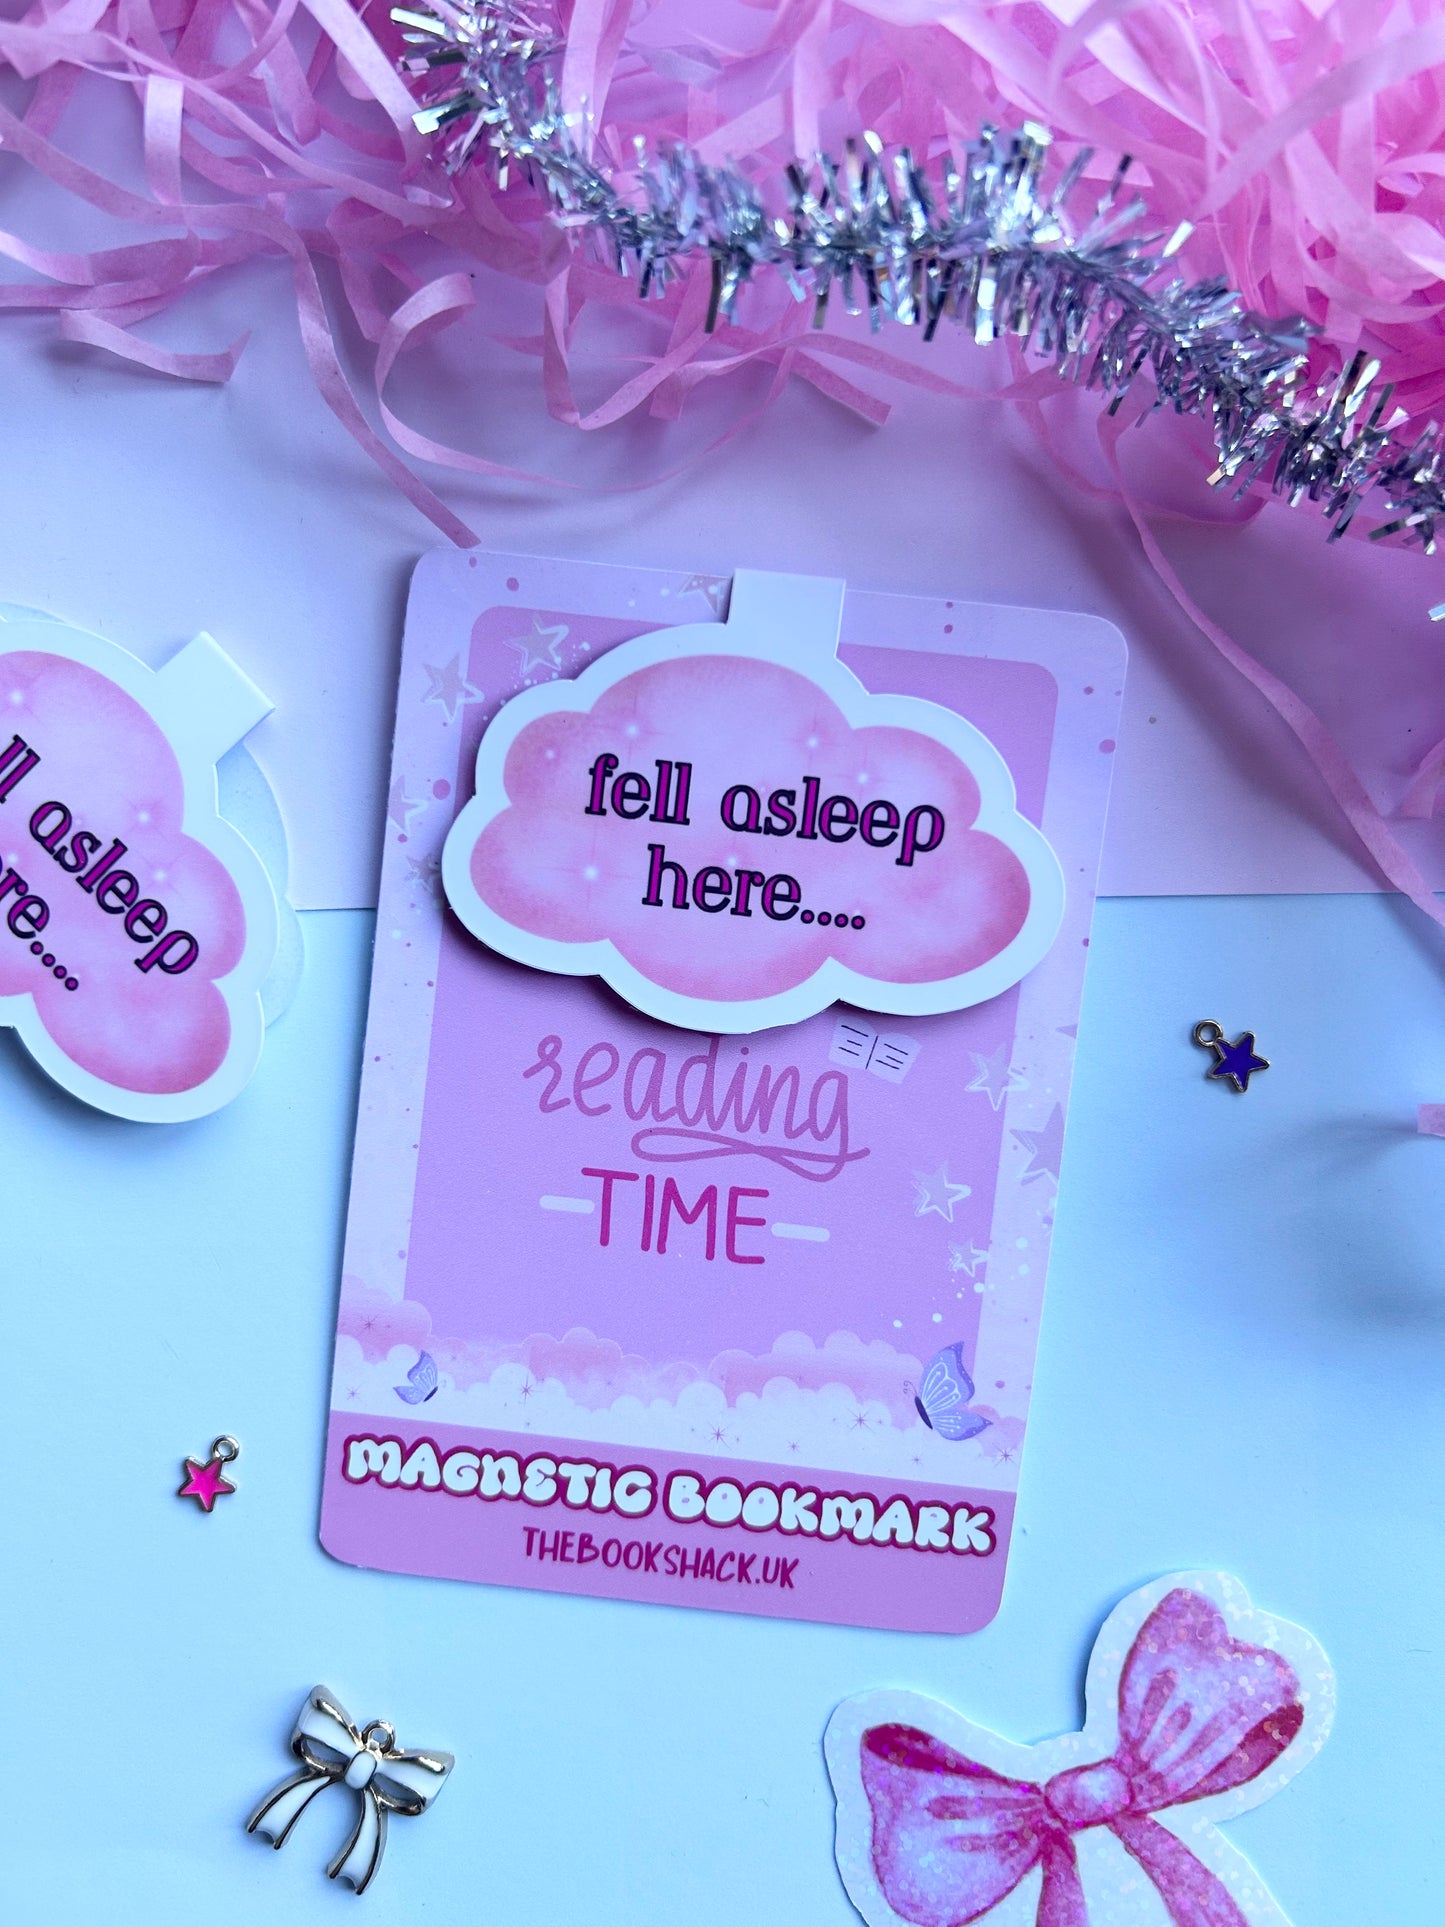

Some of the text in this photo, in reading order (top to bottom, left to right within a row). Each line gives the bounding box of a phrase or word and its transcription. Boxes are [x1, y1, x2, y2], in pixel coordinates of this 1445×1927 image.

[0, 734, 199, 975] ll asleep
[585, 753, 945, 867] fell asleep
[0, 855, 79, 991] re....
[642, 843, 866, 930] here....
[523, 1036, 871, 1182] reading
[581, 1167, 769, 1264] TIME
[342, 1432, 996, 1557] MAGNETIC BOOKMARK
[523, 1526, 799, 1589] THEBOOKSHACK.UK
